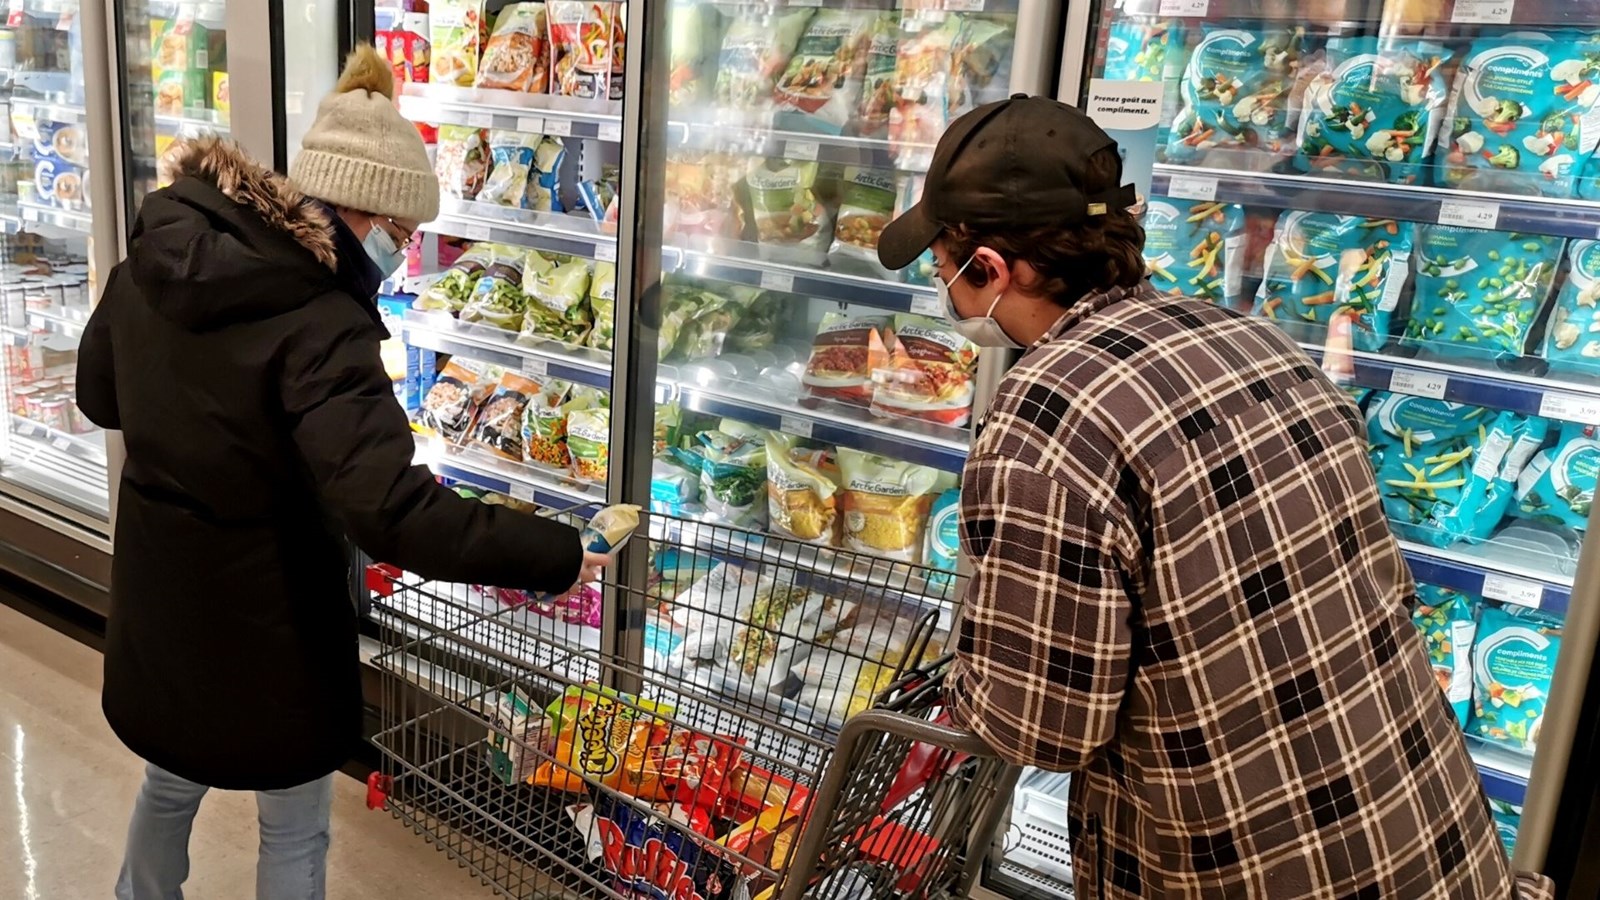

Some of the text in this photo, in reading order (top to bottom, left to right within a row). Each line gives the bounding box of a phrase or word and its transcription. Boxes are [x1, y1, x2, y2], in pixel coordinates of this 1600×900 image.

[1487, 64, 1544, 78] compliments
[1121, 96, 1140, 104] goût
[1097, 106, 1150, 115] compliments.
[1477, 212, 1493, 220] 4.29
[900, 325, 923, 336] Arctic
[1427, 382, 1442, 391] 4.29
[850, 480, 874, 491] Arctic
[1496, 648, 1548, 661] compliments
